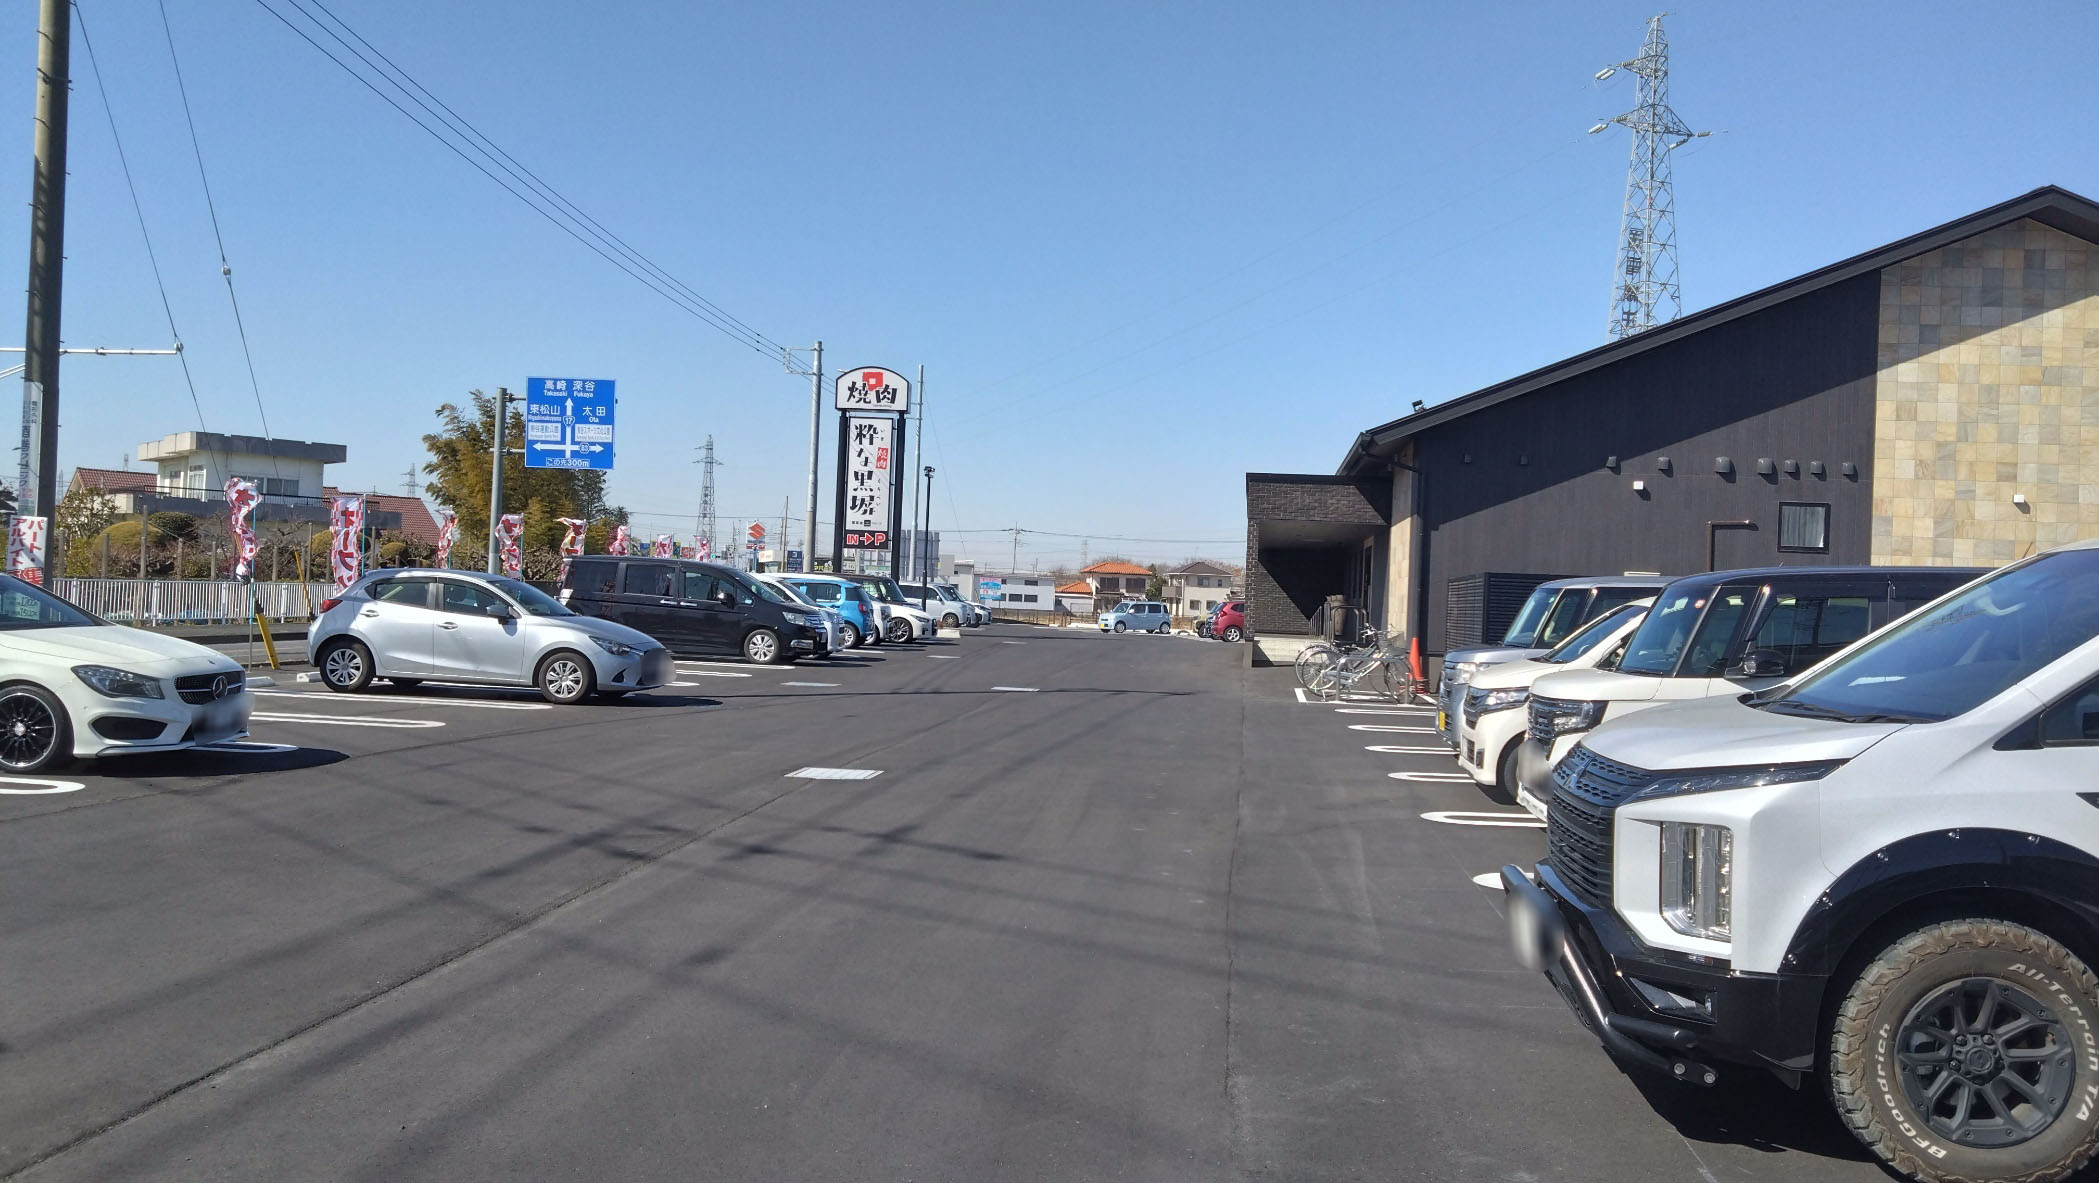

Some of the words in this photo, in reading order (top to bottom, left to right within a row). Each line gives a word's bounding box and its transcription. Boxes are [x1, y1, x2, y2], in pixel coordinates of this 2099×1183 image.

[544, 380, 566, 391] 高崎
[573, 380, 595, 391] 深谷
[847, 381, 897, 404] 焼肉
[529, 404, 560, 415] 東松山
[582, 406, 606, 416] 太田
[850, 423, 879, 516] 粋な黒塀
[10, 517, 27, 567] アルバイト
[847, 534, 859, 545] IN
[875, 533, 885, 545] P
[2008, 962, 2099, 1071] All-Terrain
[2075, 1083, 2099, 1122] T/A
[1873, 1022, 1947, 1160] BFGoodrich
